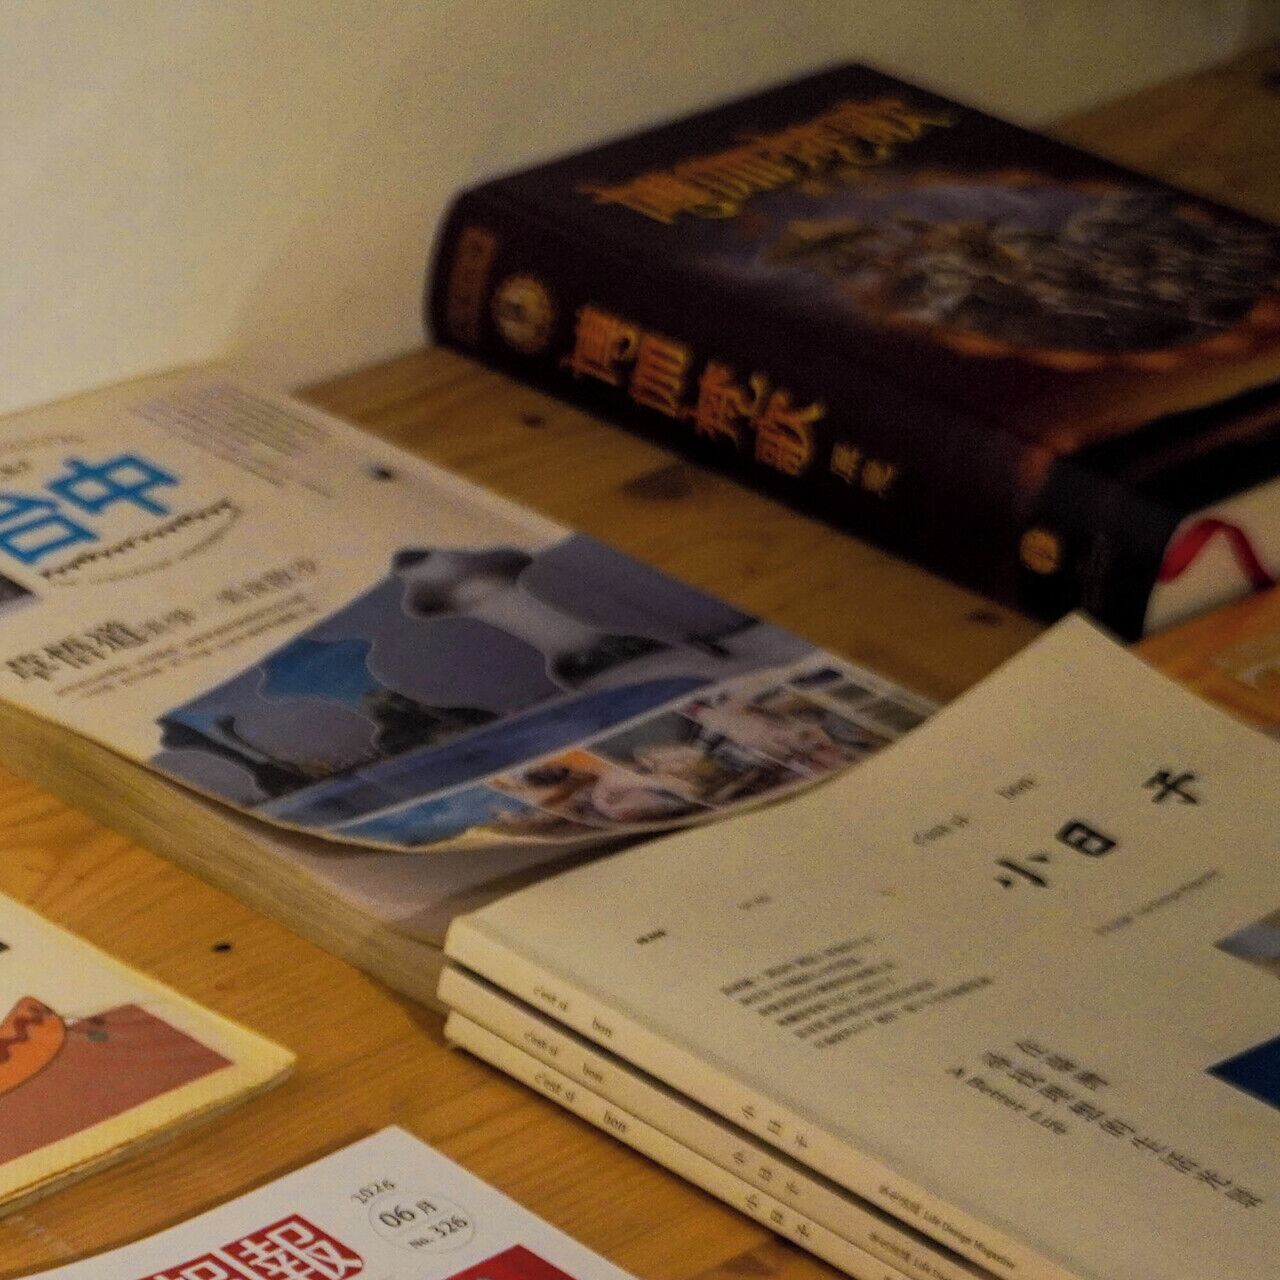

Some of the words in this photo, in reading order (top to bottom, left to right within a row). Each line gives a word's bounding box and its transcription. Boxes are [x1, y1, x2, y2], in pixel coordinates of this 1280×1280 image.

[993, 769, 1201, 889] 小日子
[376, 1200, 417, 1232] 06
